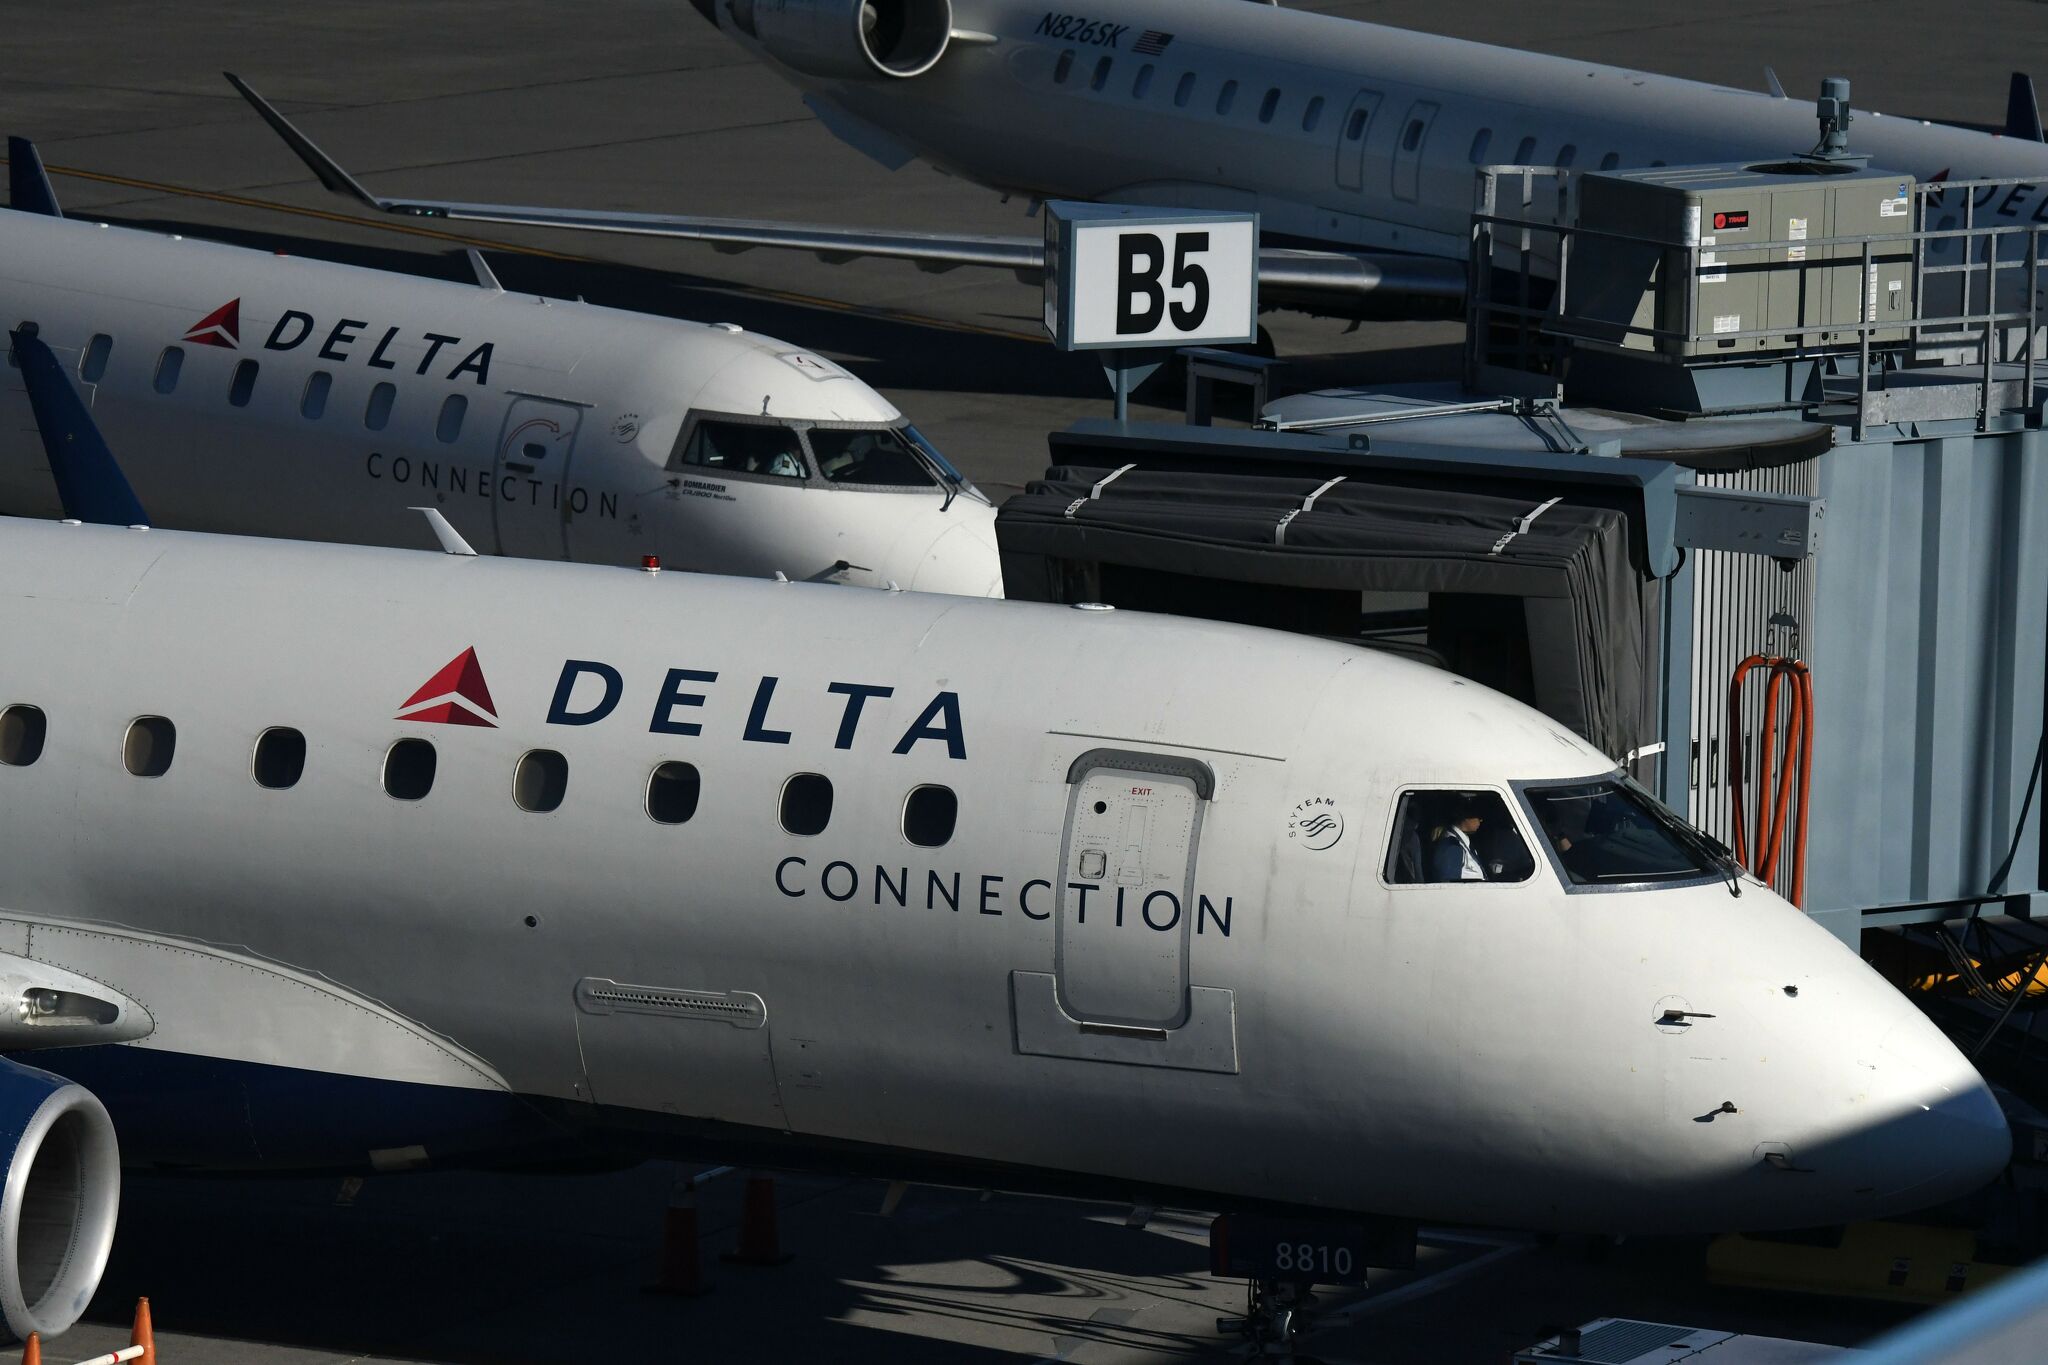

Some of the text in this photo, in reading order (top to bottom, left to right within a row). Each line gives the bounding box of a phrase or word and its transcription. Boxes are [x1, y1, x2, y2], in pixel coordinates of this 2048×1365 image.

[1035, 12, 1129, 48] N826SK
[1116, 232, 1210, 335] B5
[264, 310, 495, 386] DELTA
[367, 453, 618, 519] CONNECTION
[546, 659, 967, 760] DELTA
[1131, 786, 1152, 797] EXIT
[1288, 797, 1335, 838] SKYTEAM
[775, 857, 1233, 937] CONNECTION
[1276, 1242, 1353, 1275] 8810
